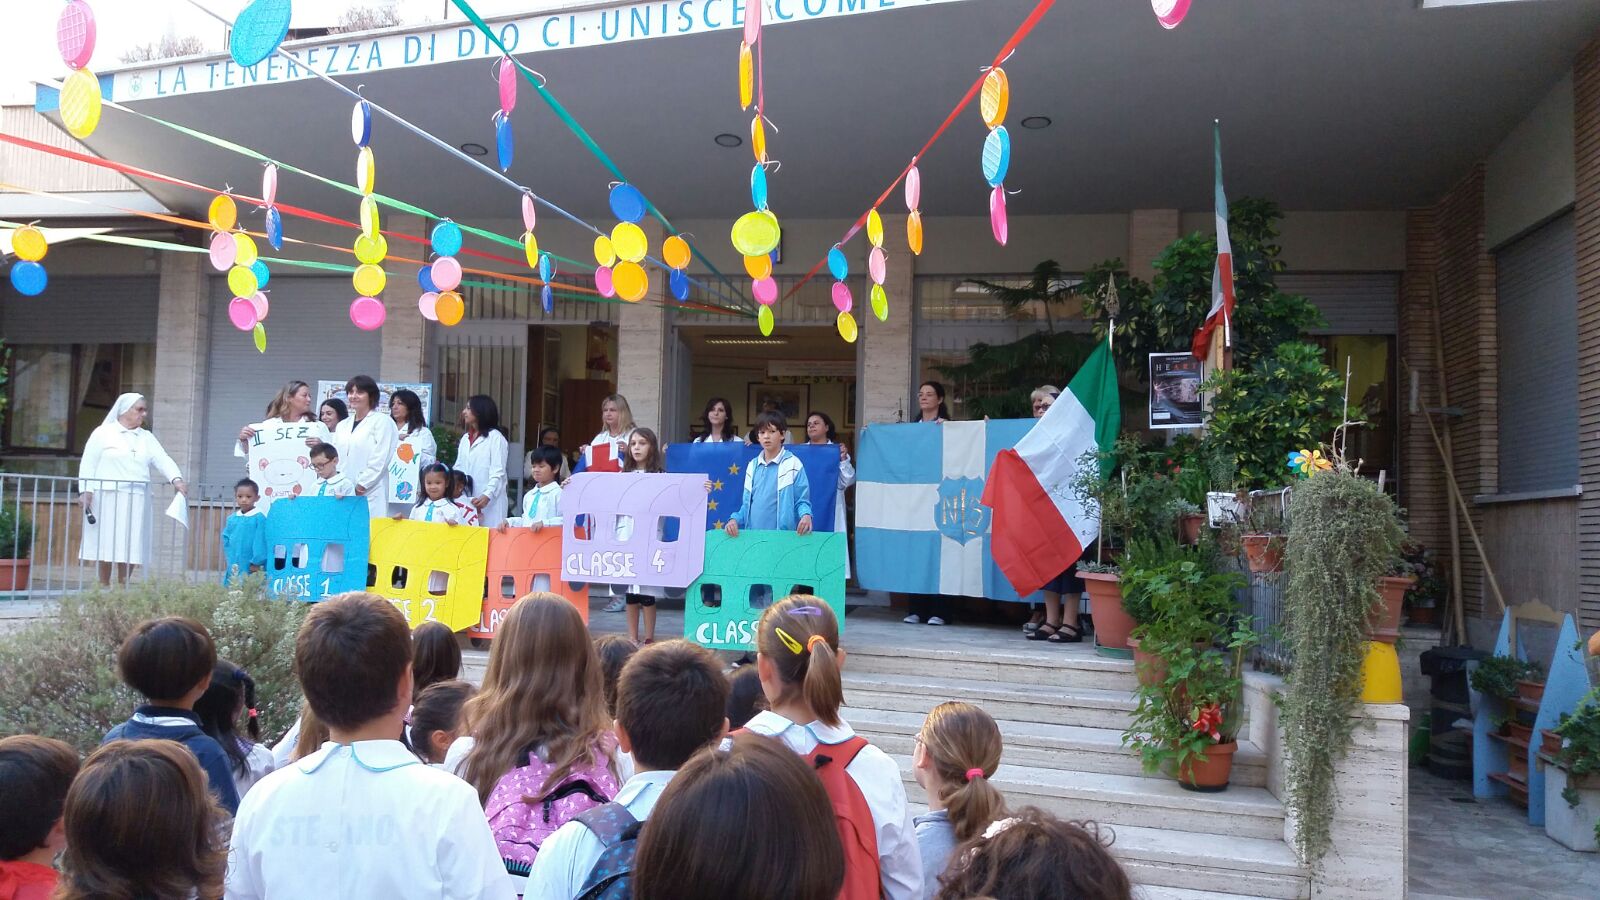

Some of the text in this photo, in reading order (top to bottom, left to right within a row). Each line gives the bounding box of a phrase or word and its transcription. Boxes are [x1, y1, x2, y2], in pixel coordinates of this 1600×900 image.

[157, 66, 187, 96] LA
[206, 40, 383, 89] TENEREZZA
[404, 33, 436, 65] DI
[457, 23, 519, 58] DIO
[542, 15, 575, 48] CI
[601, 0, 745, 41] UNISCE
[775, 0, 895, 20] CO
[274, 426, 310, 441] SEZ
[566, 549, 665, 577] CLASSE 4
[320, 577, 331, 597] 1
[422, 598, 437, 621] 2
[270, 813, 395, 847] STEANO
